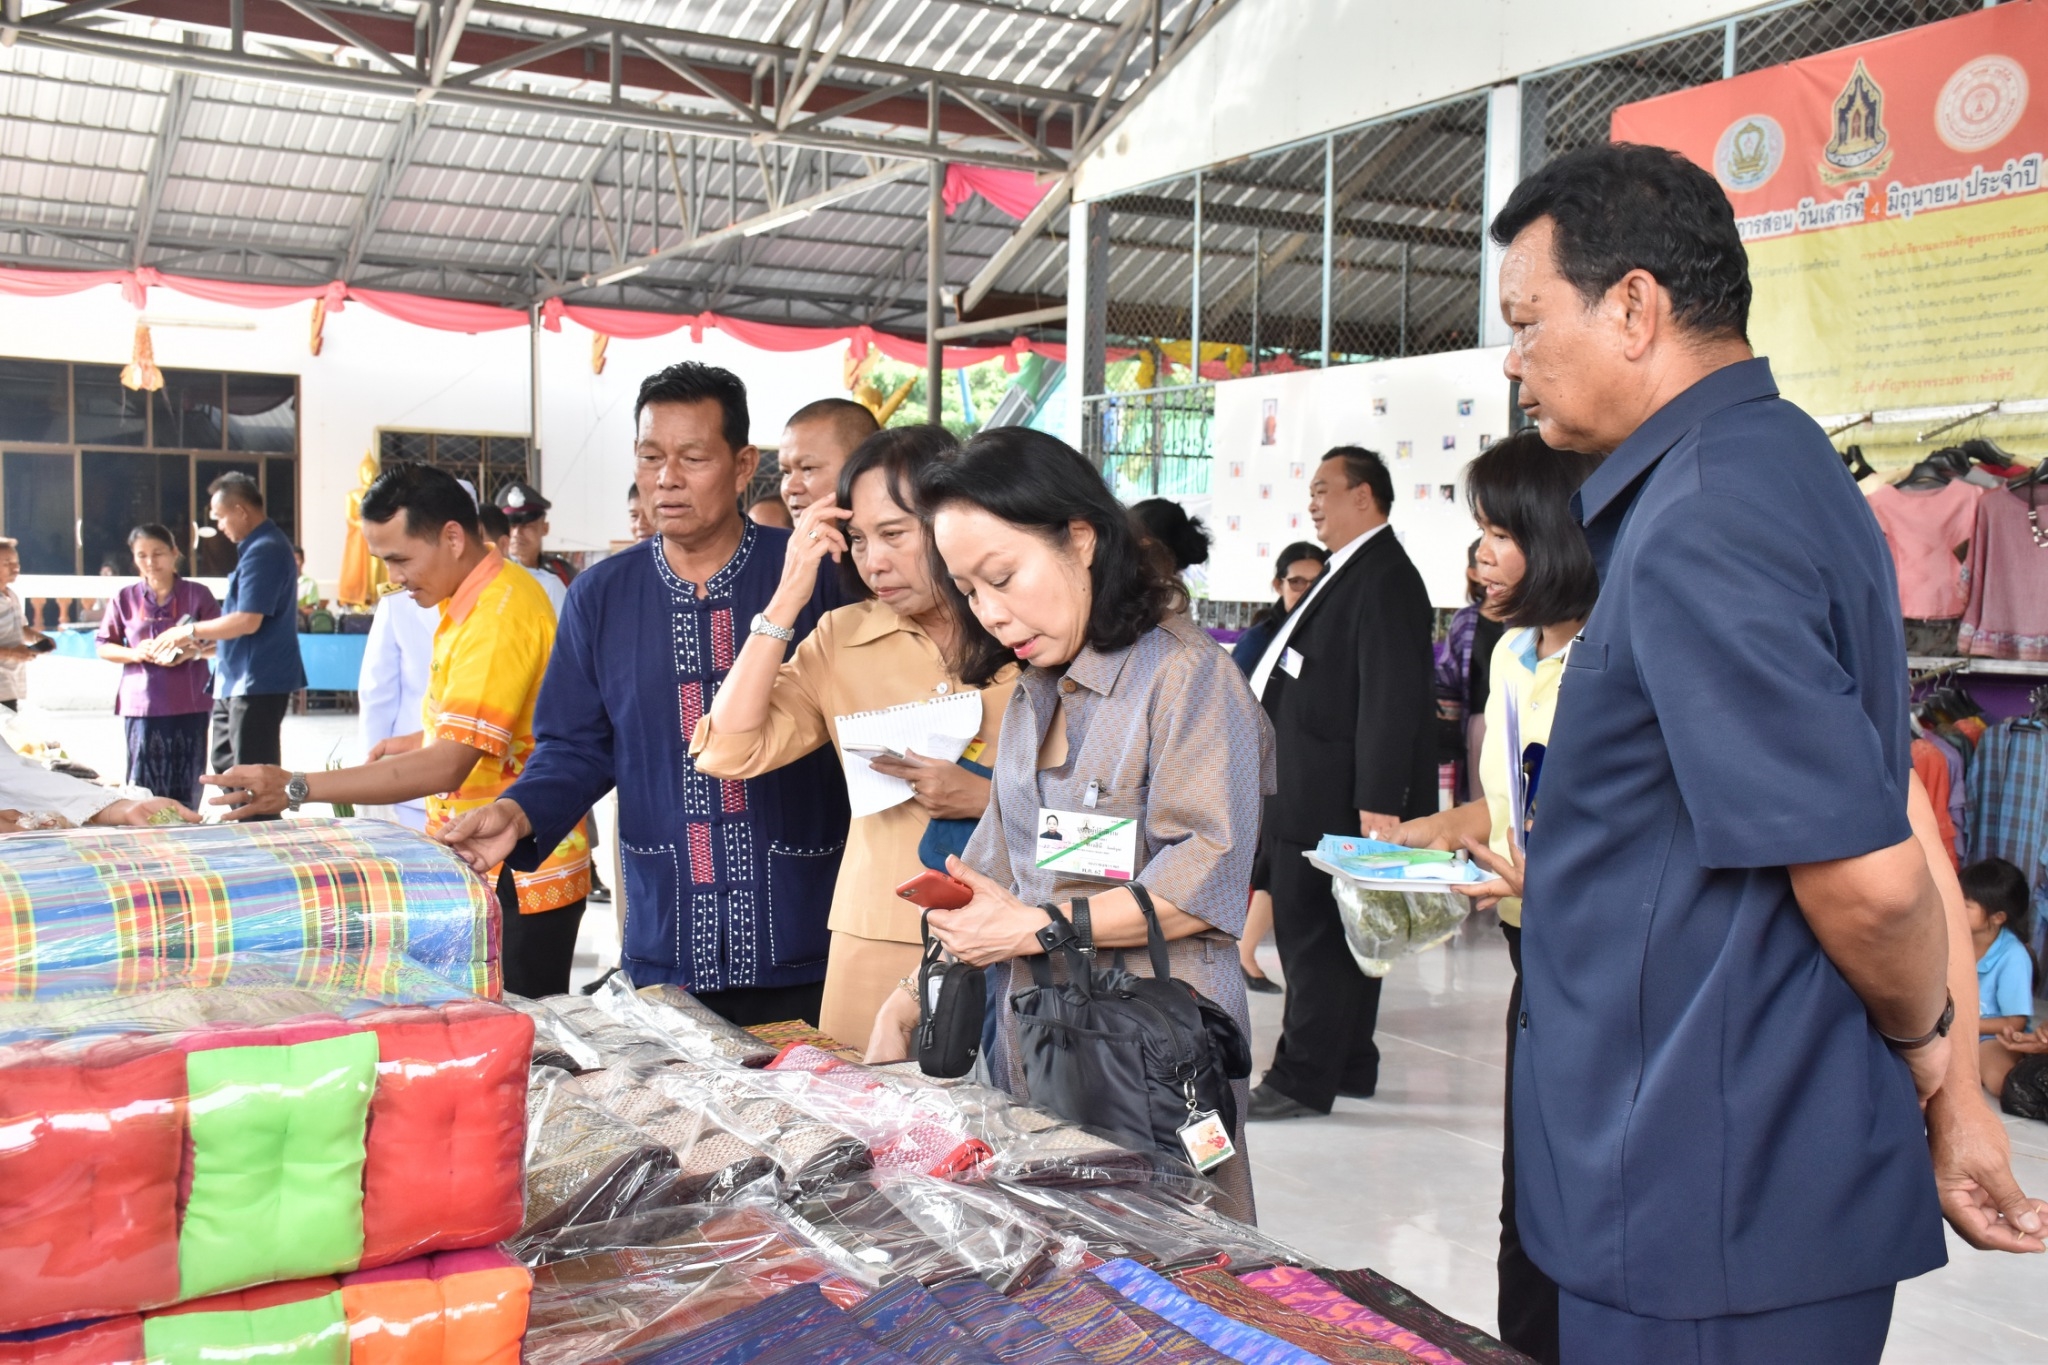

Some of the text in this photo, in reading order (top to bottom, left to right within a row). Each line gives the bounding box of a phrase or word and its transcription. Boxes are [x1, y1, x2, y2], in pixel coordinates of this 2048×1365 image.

[1798, 186, 1866, 226] วันเสาร์ที่
[1870, 201, 1881, 216] 4
[1888, 185, 1958, 217] มิถุนายน
[1966, 158, 2039, 198] ประจำปี
